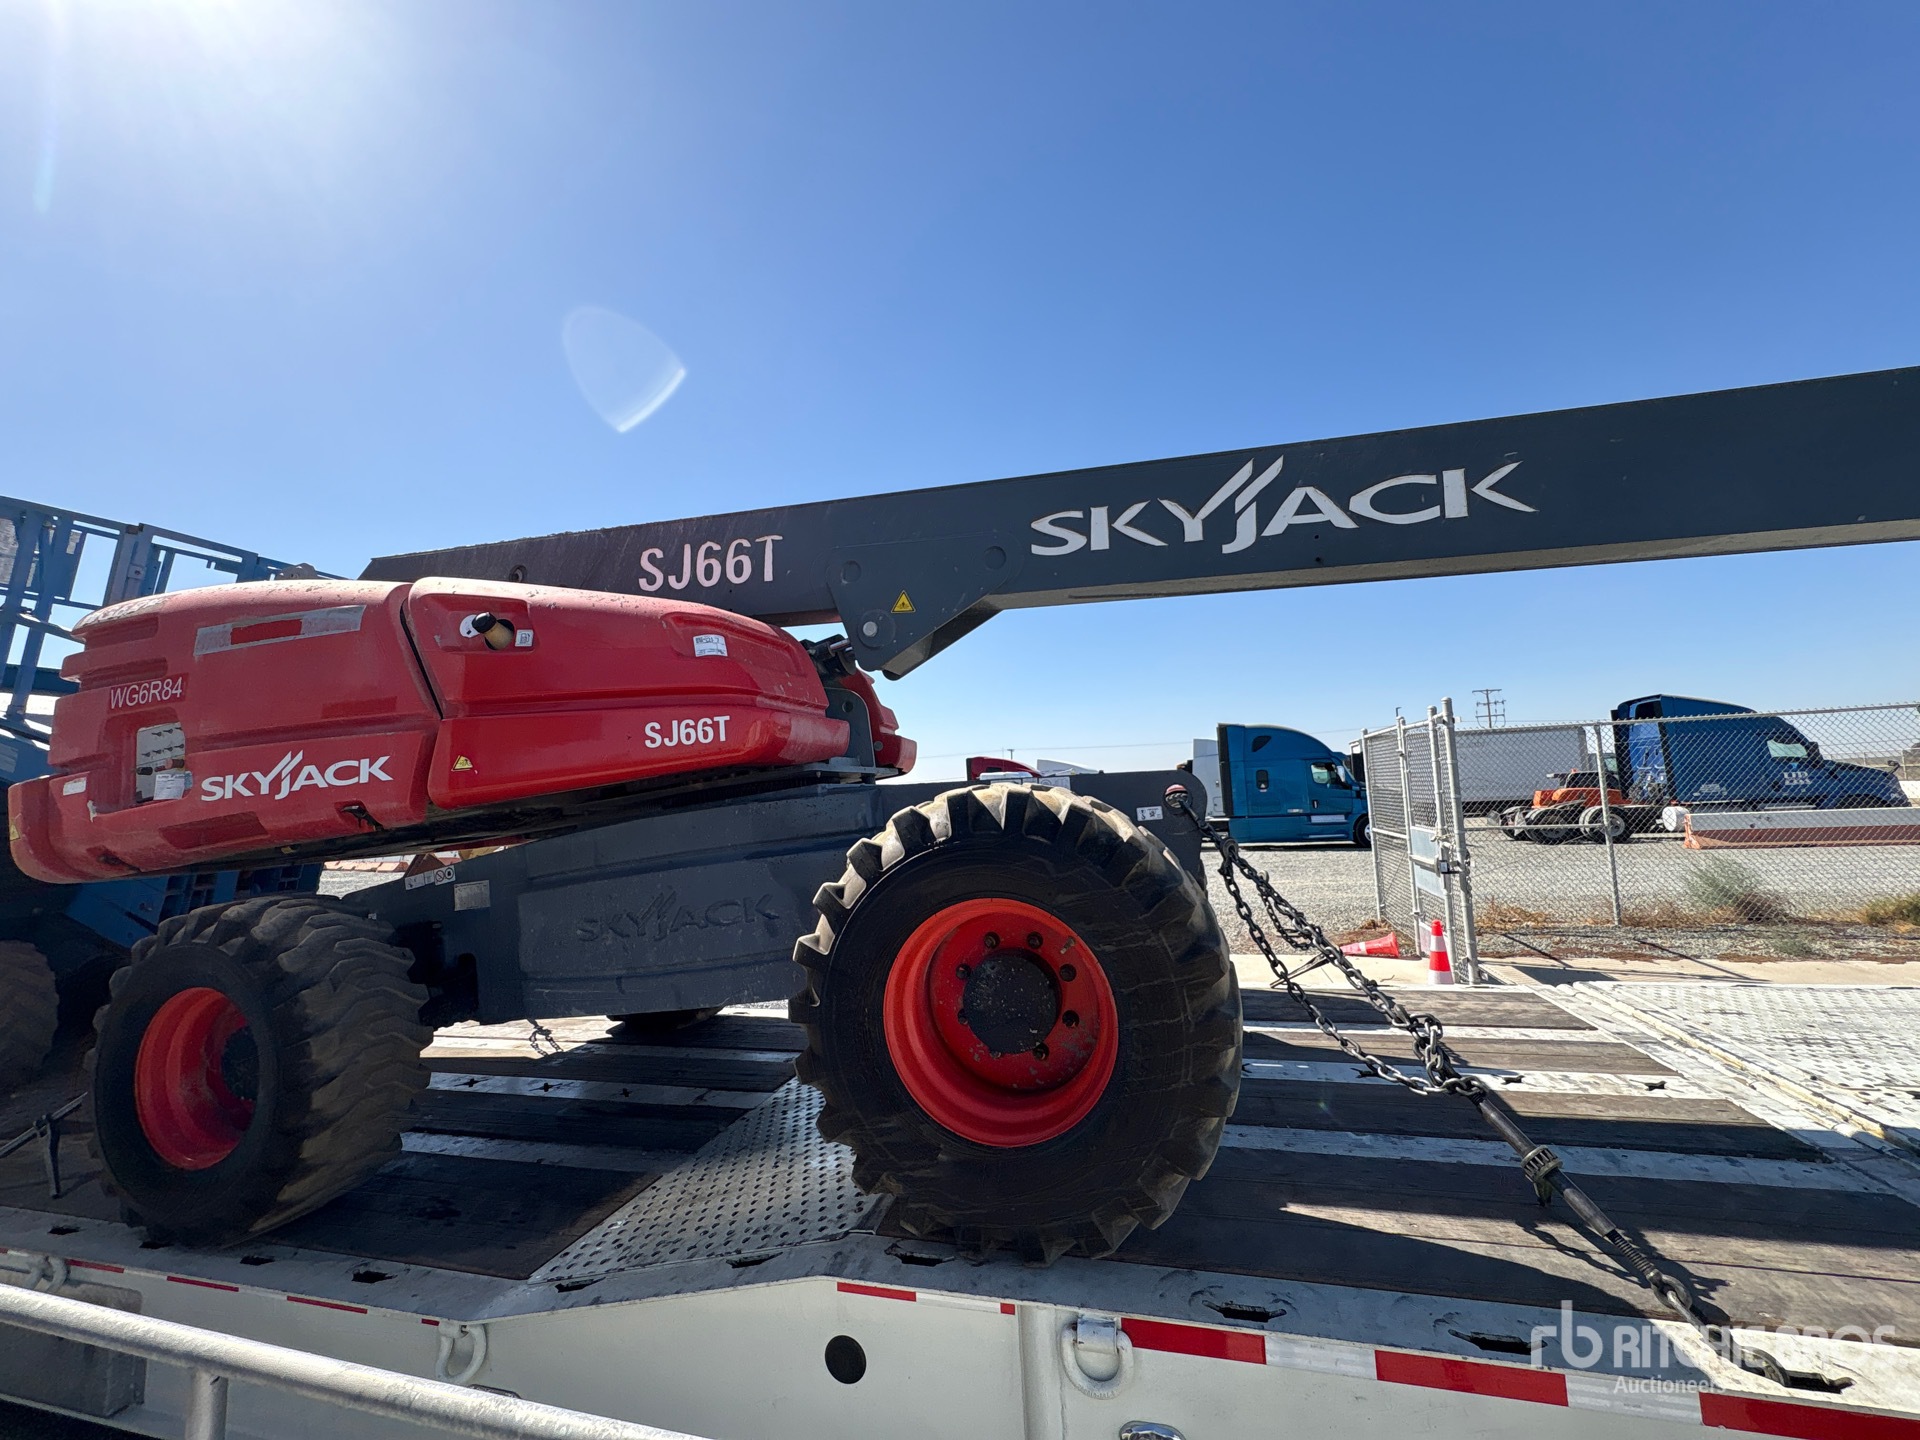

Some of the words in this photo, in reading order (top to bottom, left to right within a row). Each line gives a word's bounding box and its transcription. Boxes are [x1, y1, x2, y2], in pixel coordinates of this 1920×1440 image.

[1030, 455, 1538, 556] SKYJACK
[638, 534, 784, 592] SJ66T
[110, 676, 183, 709] WG6R84
[644, 715, 731, 749] SJ66T
[200, 750, 394, 802] SKYJACK
[576, 891, 780, 942] SKYJACK
